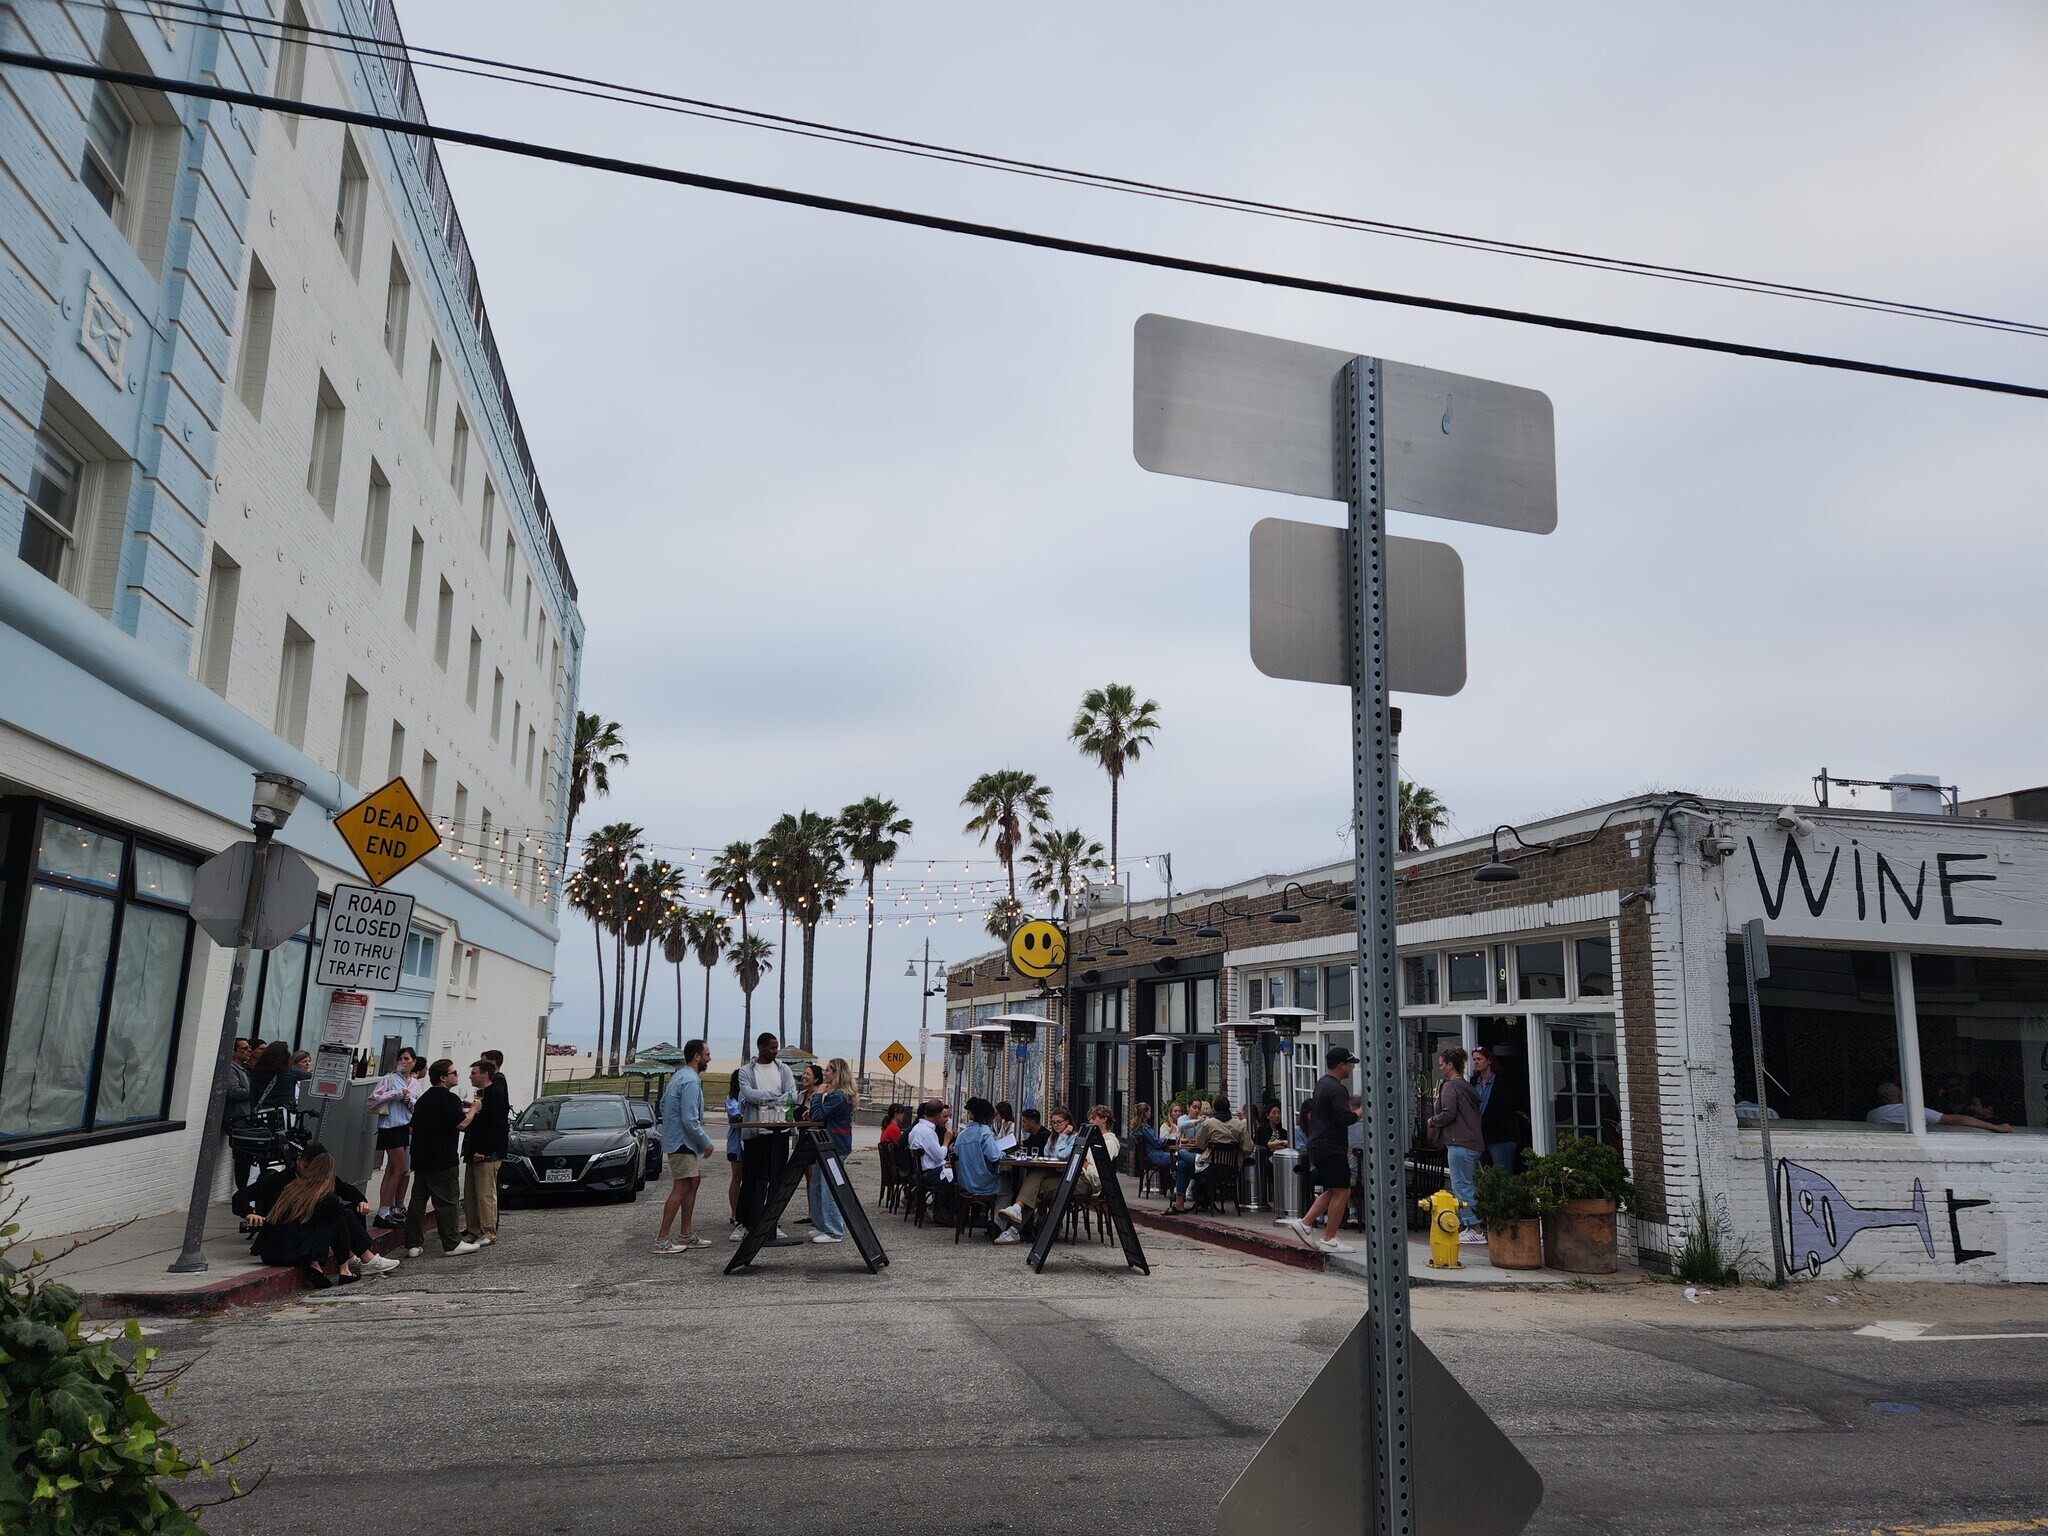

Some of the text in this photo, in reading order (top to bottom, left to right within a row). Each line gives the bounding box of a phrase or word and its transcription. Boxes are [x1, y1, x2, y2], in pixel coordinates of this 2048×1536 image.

[363, 805, 419, 833] DEAD
[366, 835, 407, 859] END
[348, 894, 396, 917] ROAD
[334, 914, 401, 939] CLOSED
[333, 939, 393, 960] TO THRU
[329, 960, 391, 981] TRAFFIC
[1500, 968, 1506, 981] 9
[887, 1052, 904, 1062] END
